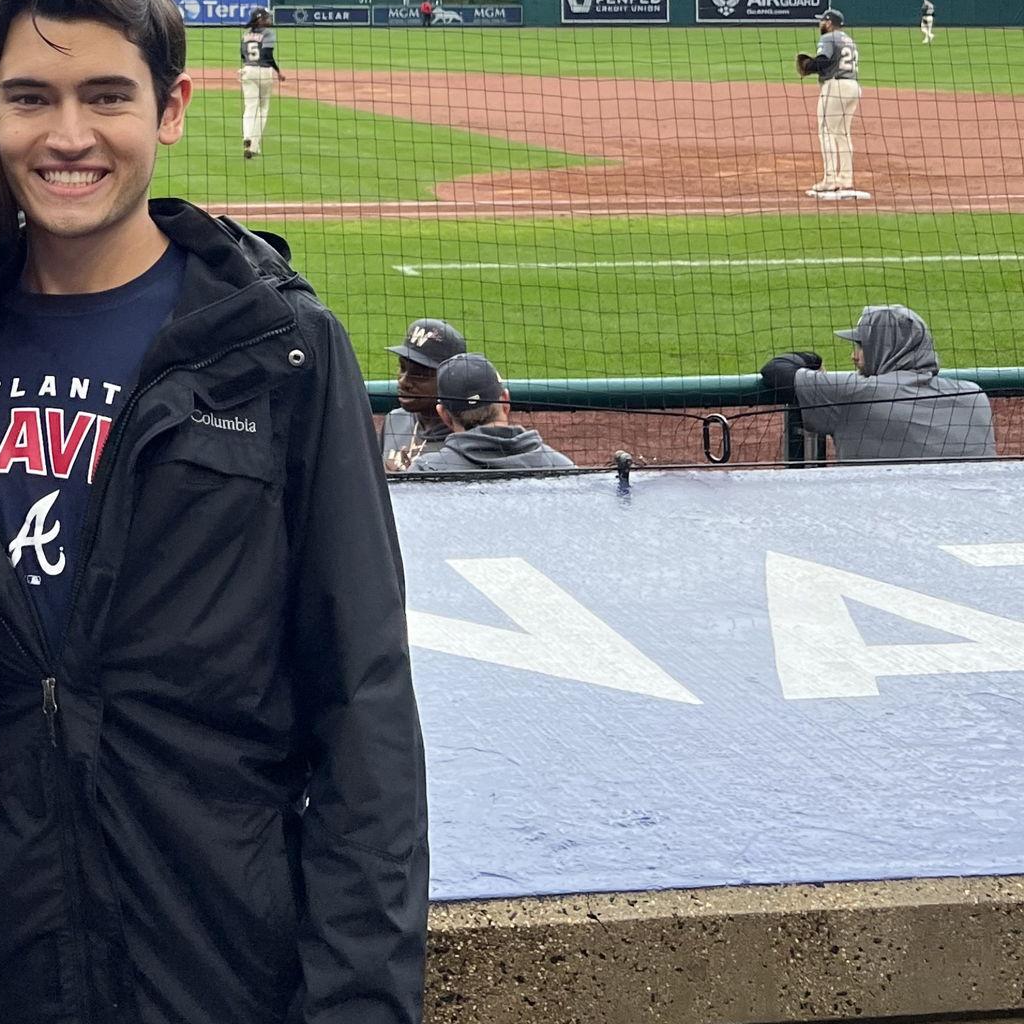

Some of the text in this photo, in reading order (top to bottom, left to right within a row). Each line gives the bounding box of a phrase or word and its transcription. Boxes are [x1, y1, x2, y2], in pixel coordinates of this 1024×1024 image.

[387, 7, 420, 18] MGM
[473, 7, 506, 18] MGM
[595, 5, 627, 13] CREDIT
[313, 11, 350, 20] CLEAR
[247, 42, 260, 62] 5
[190, 408, 257, 433] Columbia
